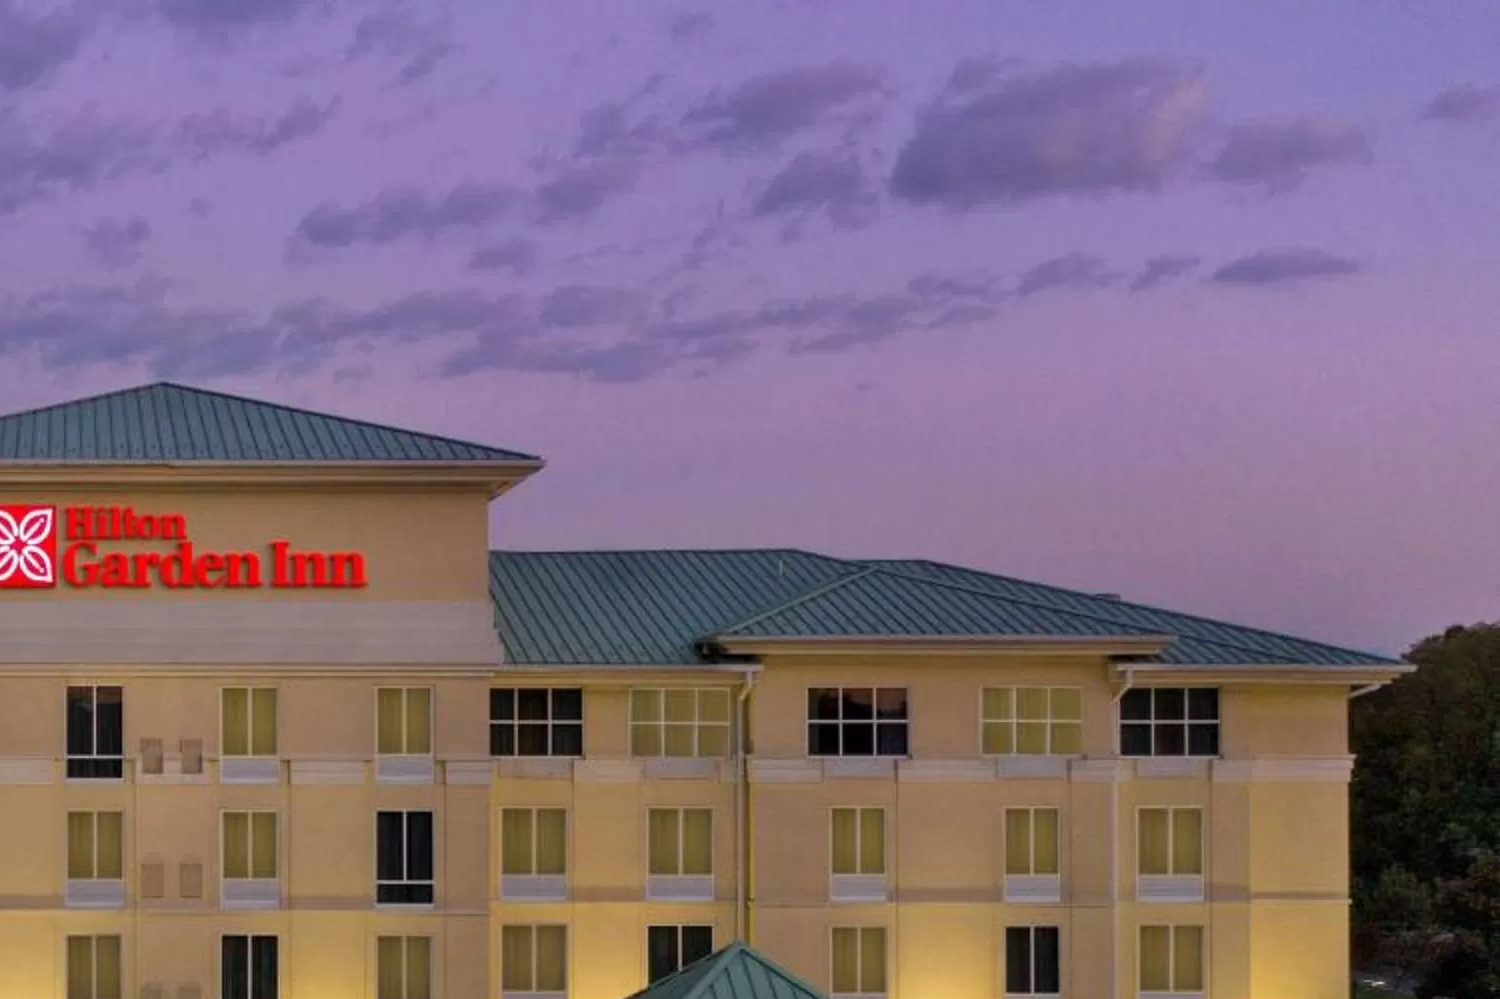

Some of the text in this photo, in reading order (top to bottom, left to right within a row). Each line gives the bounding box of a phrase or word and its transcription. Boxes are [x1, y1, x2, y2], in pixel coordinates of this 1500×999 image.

[64, 505, 188, 540] Hilton
[62, 540, 368, 588] Garden Inn
